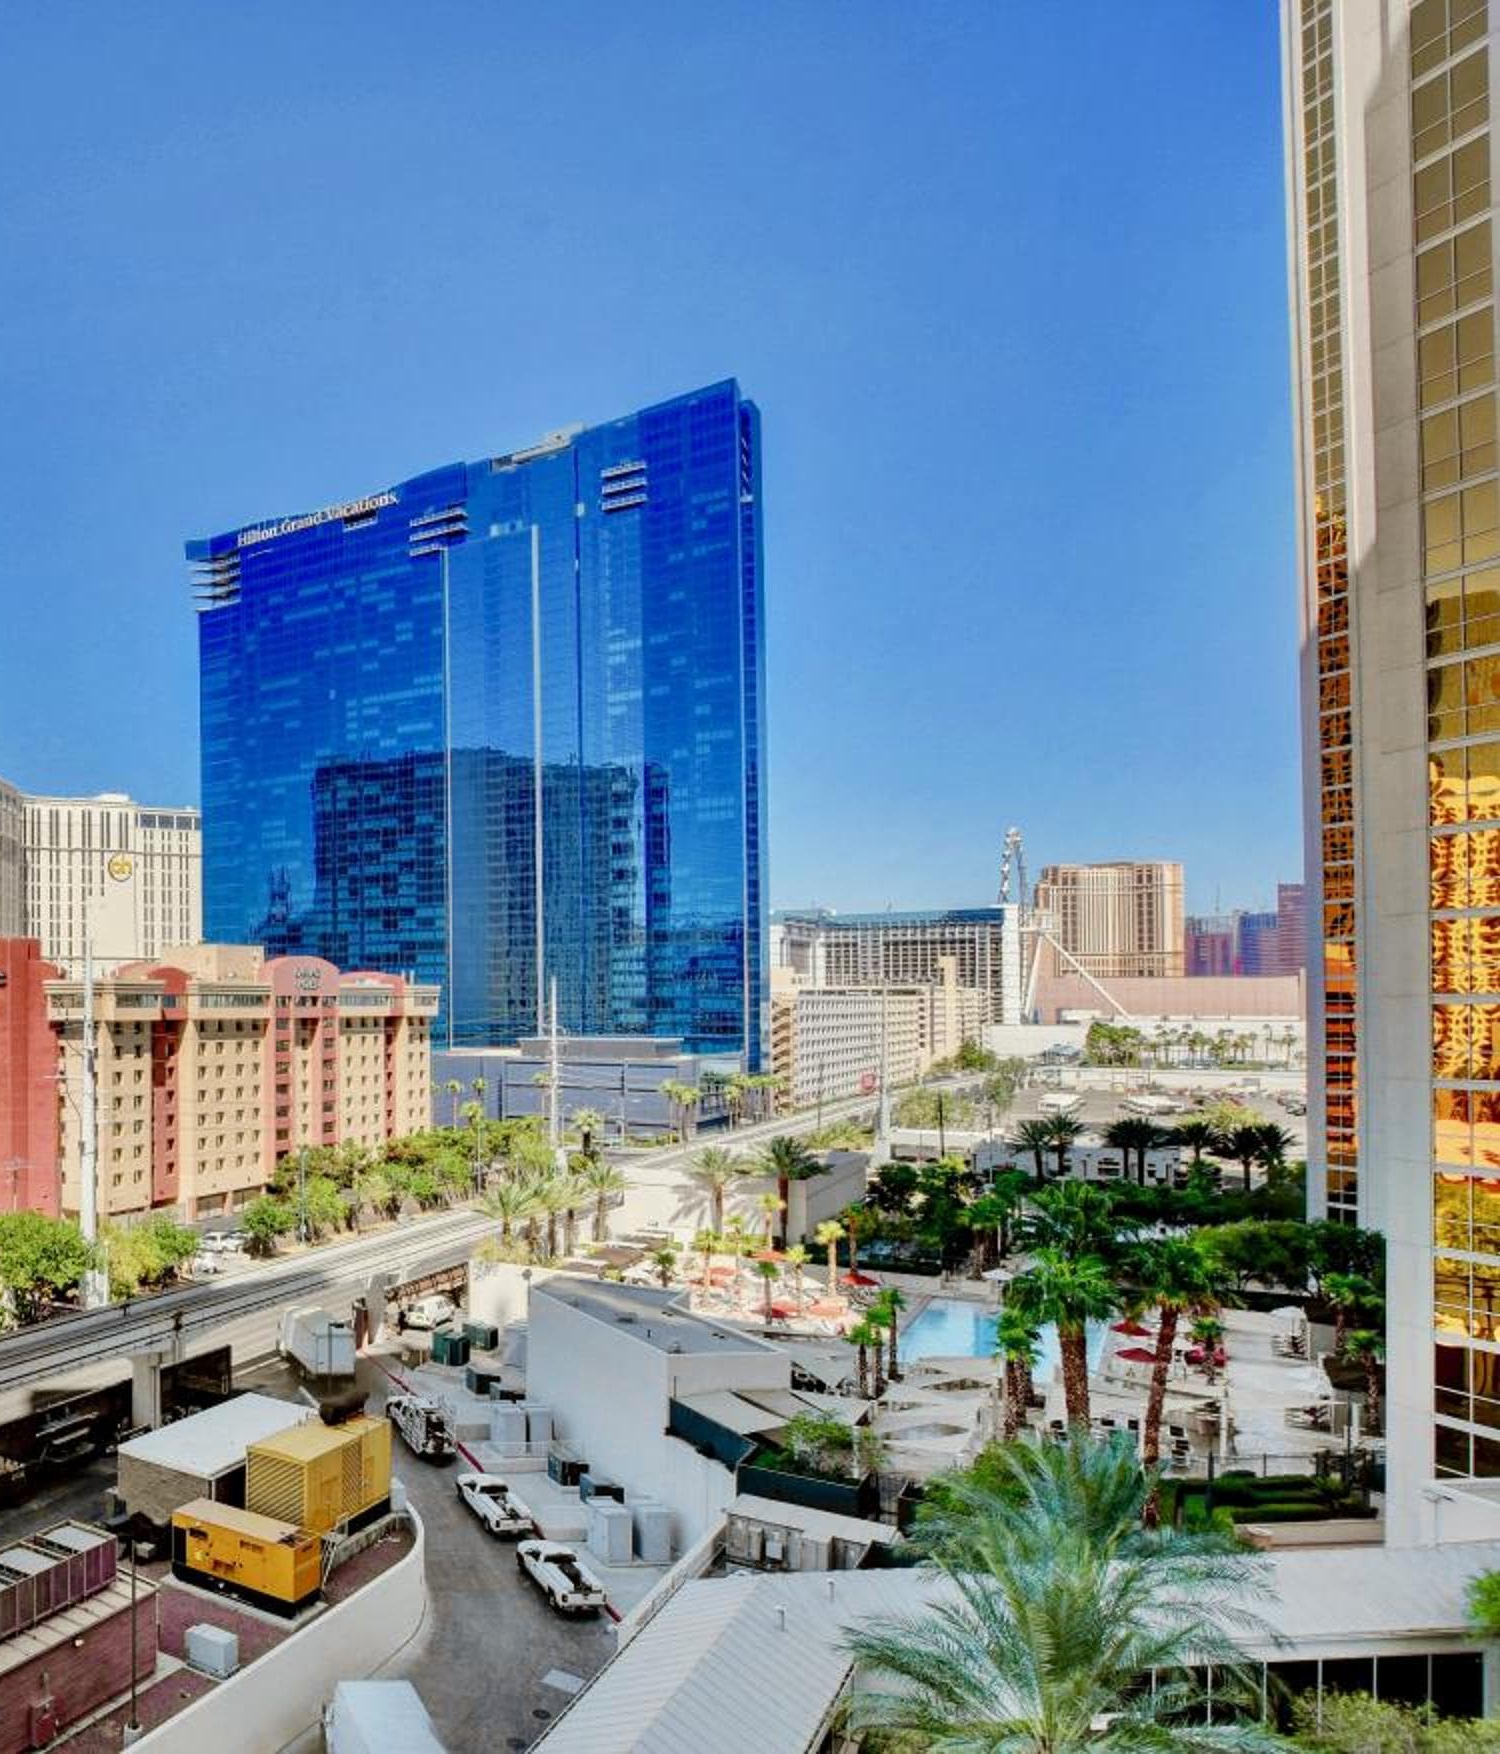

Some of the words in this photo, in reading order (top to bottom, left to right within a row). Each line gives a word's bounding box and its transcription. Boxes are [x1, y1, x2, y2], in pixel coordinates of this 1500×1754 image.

[237, 524, 278, 547] Hilton
[280, 510, 324, 535] Grand
[325, 491, 399, 520] Vacations
